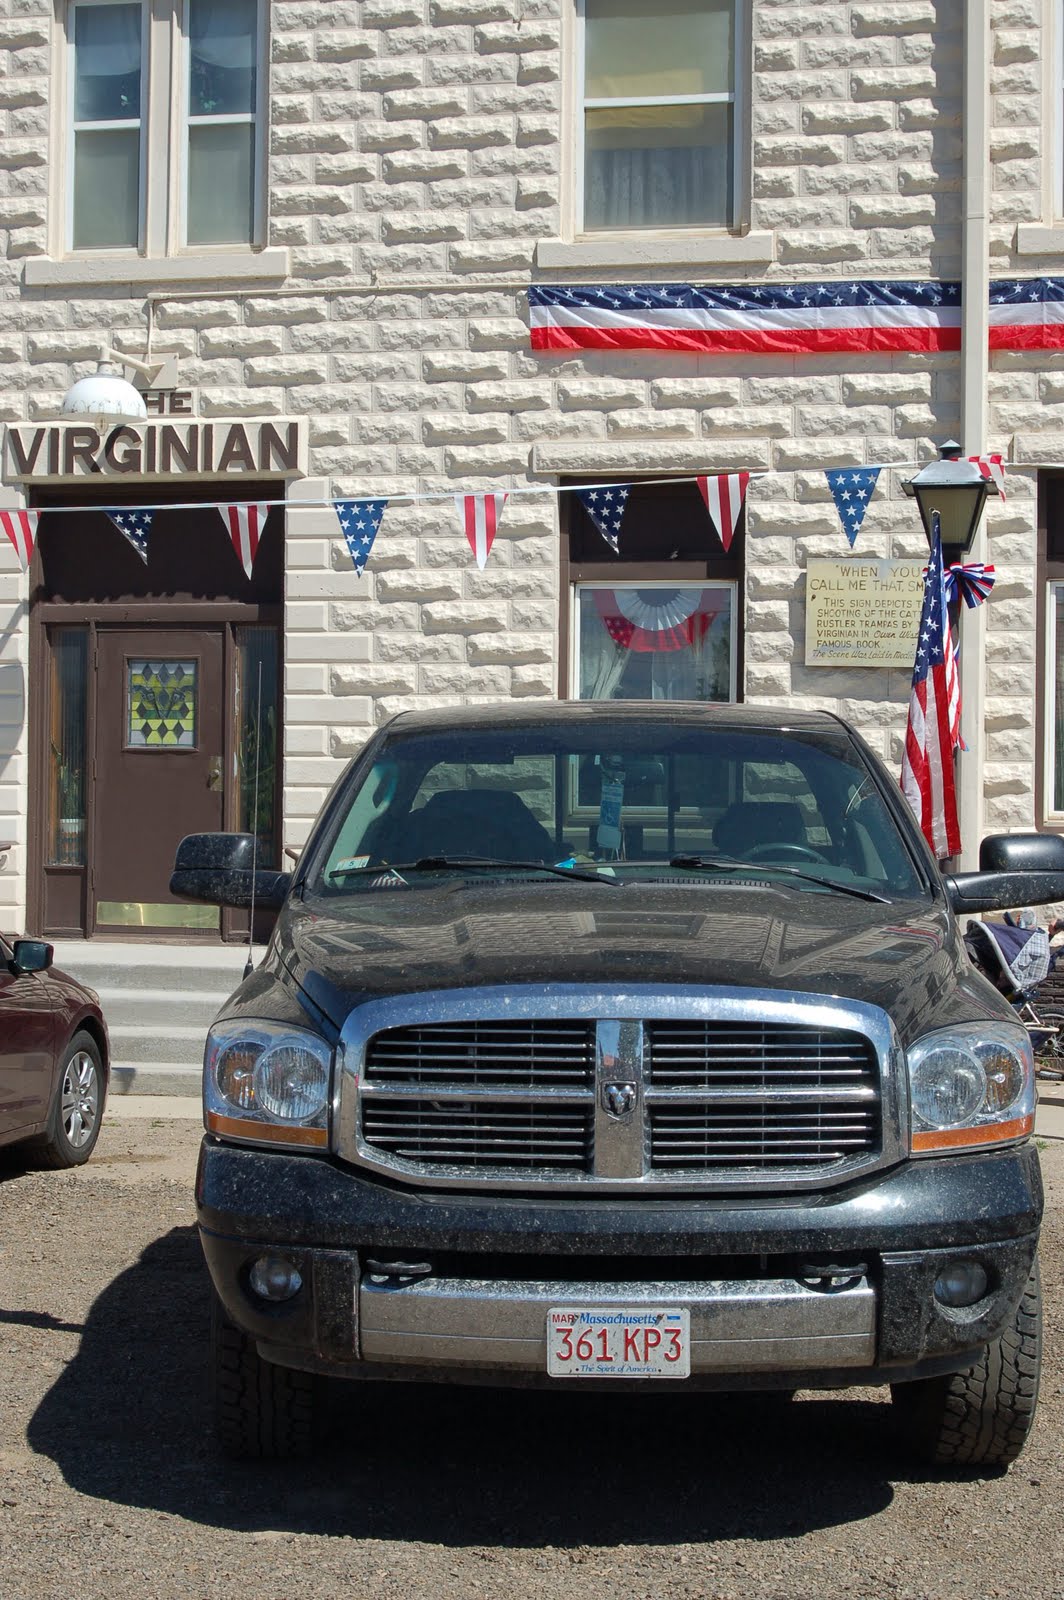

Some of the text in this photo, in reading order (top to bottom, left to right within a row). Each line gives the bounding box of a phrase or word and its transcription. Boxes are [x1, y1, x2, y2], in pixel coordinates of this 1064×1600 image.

[142, 391, 193, 414] HE
[8, 421, 299, 474] VIRGINIAN
[890, 566, 920, 578] YOU
[810, 579, 844, 591] CALL
[848, 580, 867, 591] ME
[873, 580, 905, 593] THAT,
[824, 598, 845, 608] THIS
[850, 599, 871, 608] SIGN
[875, 599, 912, 609] DEPICTS
[817, 609, 861, 618] SHOOTING
[864, 610, 876, 618] OF
[880, 610, 896, 618] THE
[816, 619, 856, 629] RUSTLER
[860, 620, 898, 629] TRAMPAS
[902, 620, 913, 629] BY
[817, 629, 859, 638] VIRGINIAN
[861, 630, 869, 638] IN
[816, 640, 852, 649] FAMOUS
[552, 1314, 575, 1323] MAR
[579, 1312, 657, 1324] Massachusetts
[556, 1328, 682, 1361] 361 KP3
[580, 1364, 657, 1374] The Spirit of America
